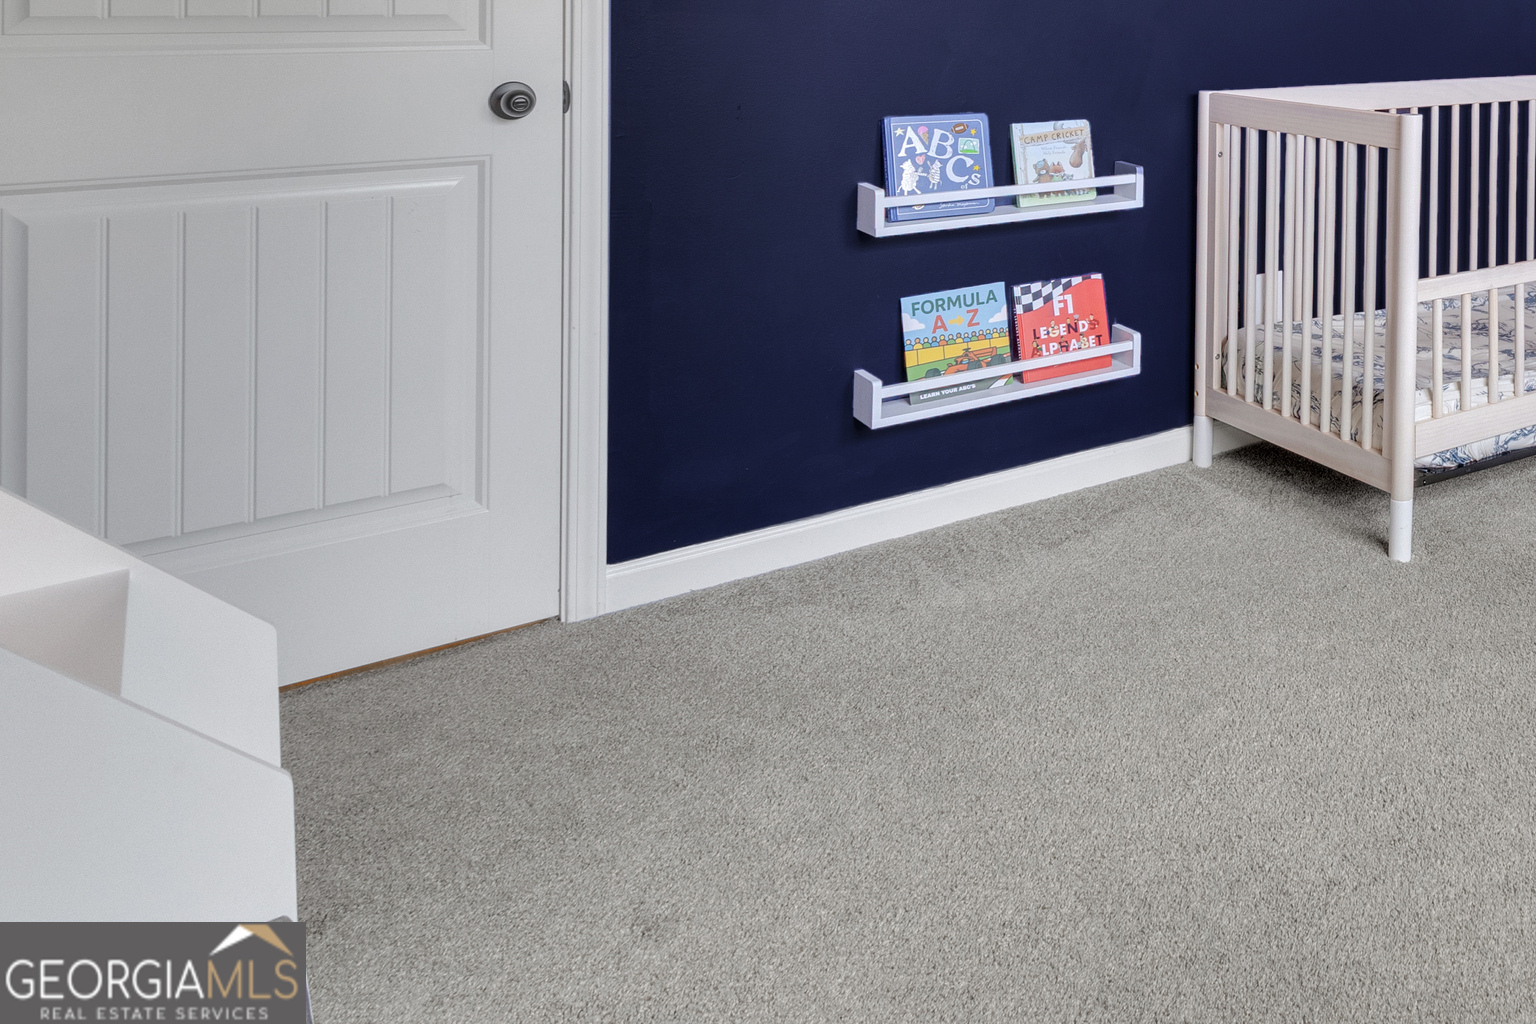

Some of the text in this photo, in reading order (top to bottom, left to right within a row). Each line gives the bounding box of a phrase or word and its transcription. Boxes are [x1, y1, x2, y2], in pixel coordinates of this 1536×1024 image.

[1023, 128, 1084, 145] CAMP CRICKET
[911, 290, 998, 317] FORMULA
[1053, 293, 1074, 316] F1
[932, 308, 980, 334] A Z
[1033, 318, 1100, 340] LEGENDS
[1031, 334, 1102, 358] ALPHABET
[920, 383, 977, 400] LEARN YOUR ABC'S
